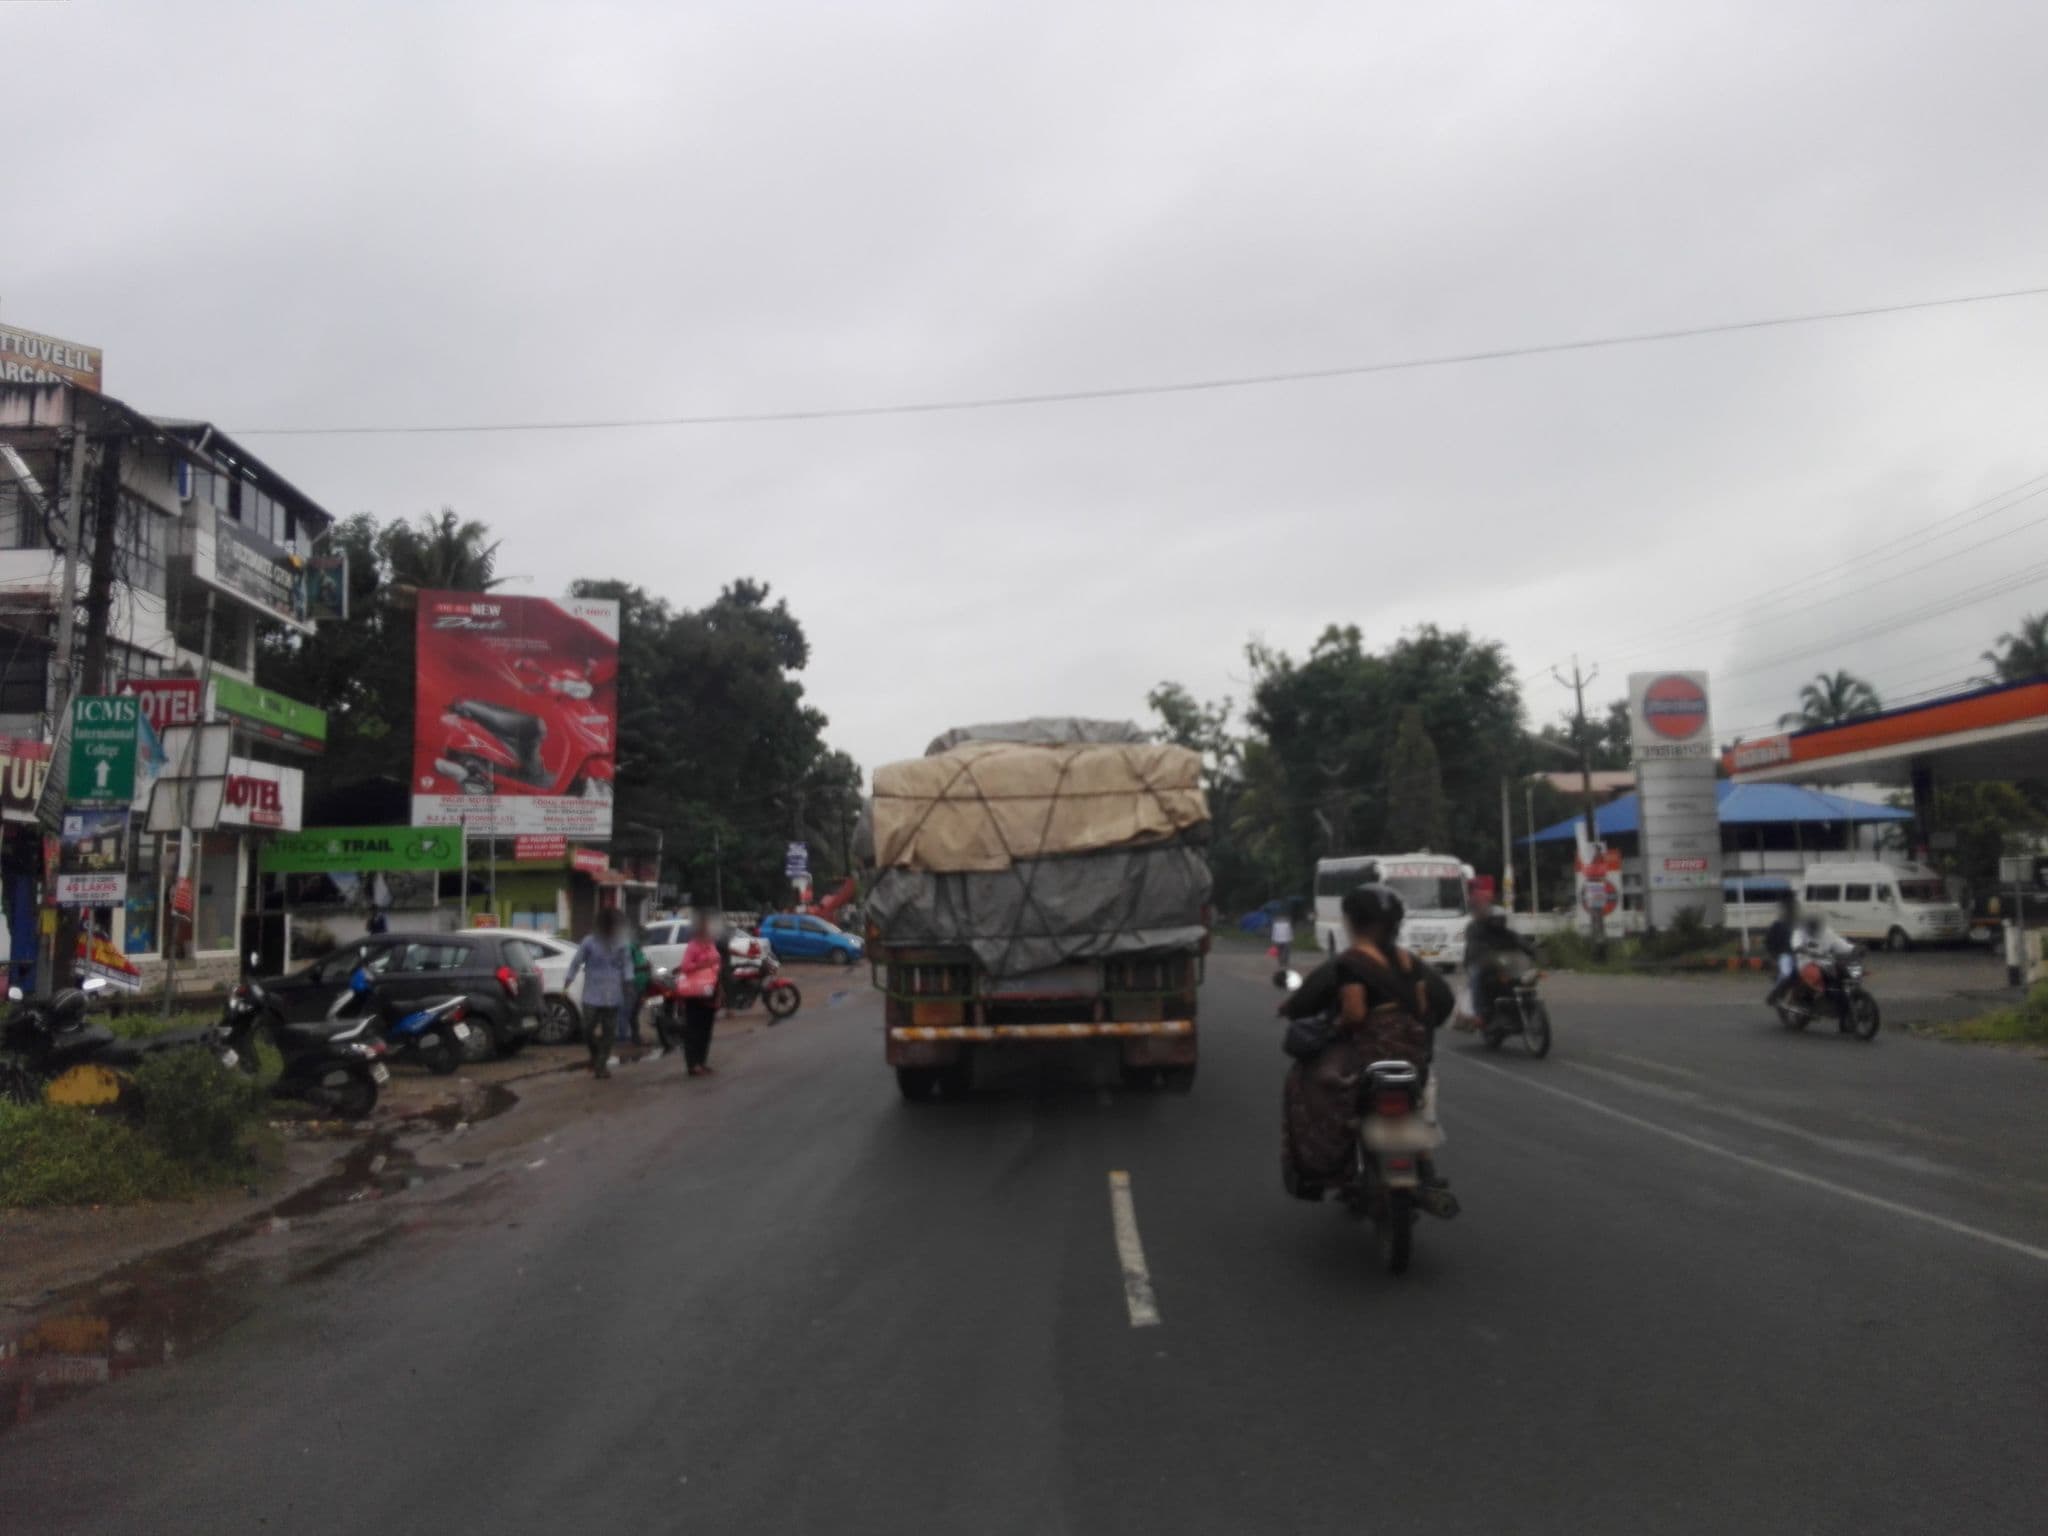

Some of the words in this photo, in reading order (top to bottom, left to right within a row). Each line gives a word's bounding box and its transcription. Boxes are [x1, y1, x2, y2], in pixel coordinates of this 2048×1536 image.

[471, 603, 502, 617] NEW
[77, 700, 136, 721] ICMS
[140, 689, 198, 723] OTEL
[75, 727, 135, 740] International
[84, 742, 120, 758] College
[342, 838, 394, 852] TRAIL
